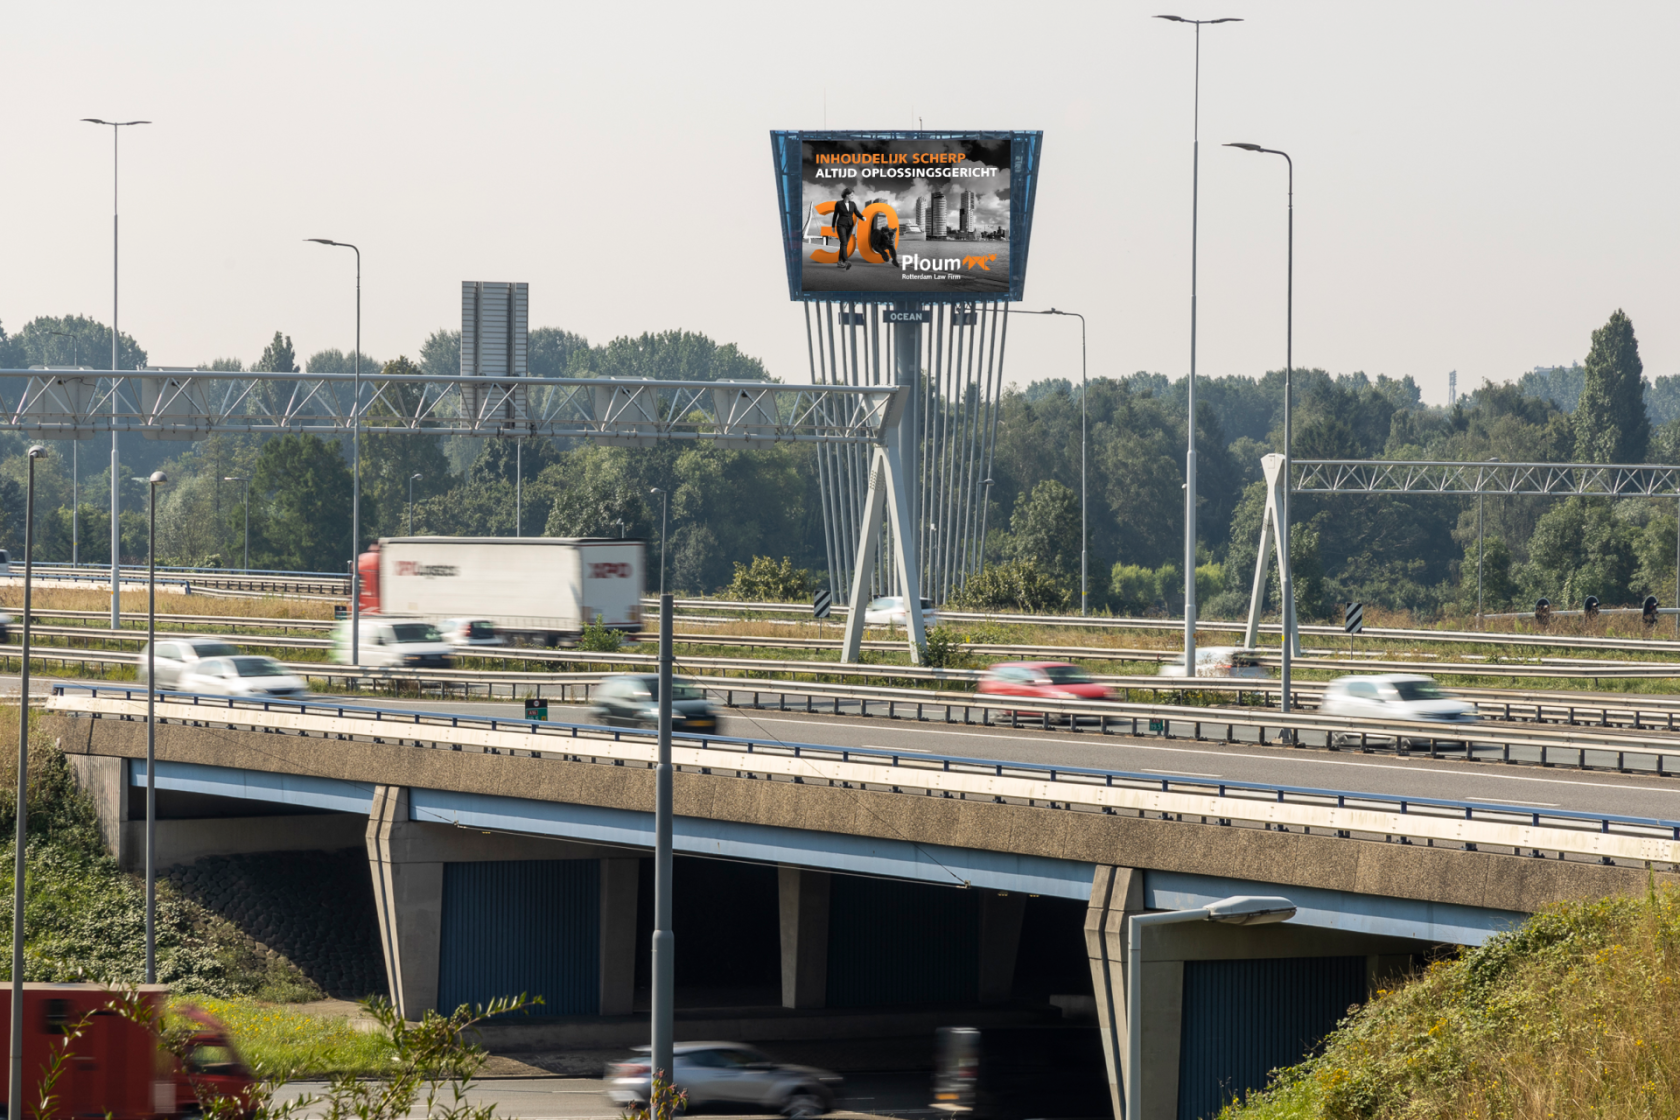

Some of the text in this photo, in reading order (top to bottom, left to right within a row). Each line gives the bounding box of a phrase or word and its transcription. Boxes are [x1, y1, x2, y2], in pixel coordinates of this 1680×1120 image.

[815, 153, 966, 164] INHOUDELIJK SCHERP
[815, 167, 998, 178] ALTIJD OPLOSSINGSGERICHT
[809, 200, 900, 264] 30
[901, 253, 961, 271] Ploum
[890, 312, 923, 321] OCEAN
